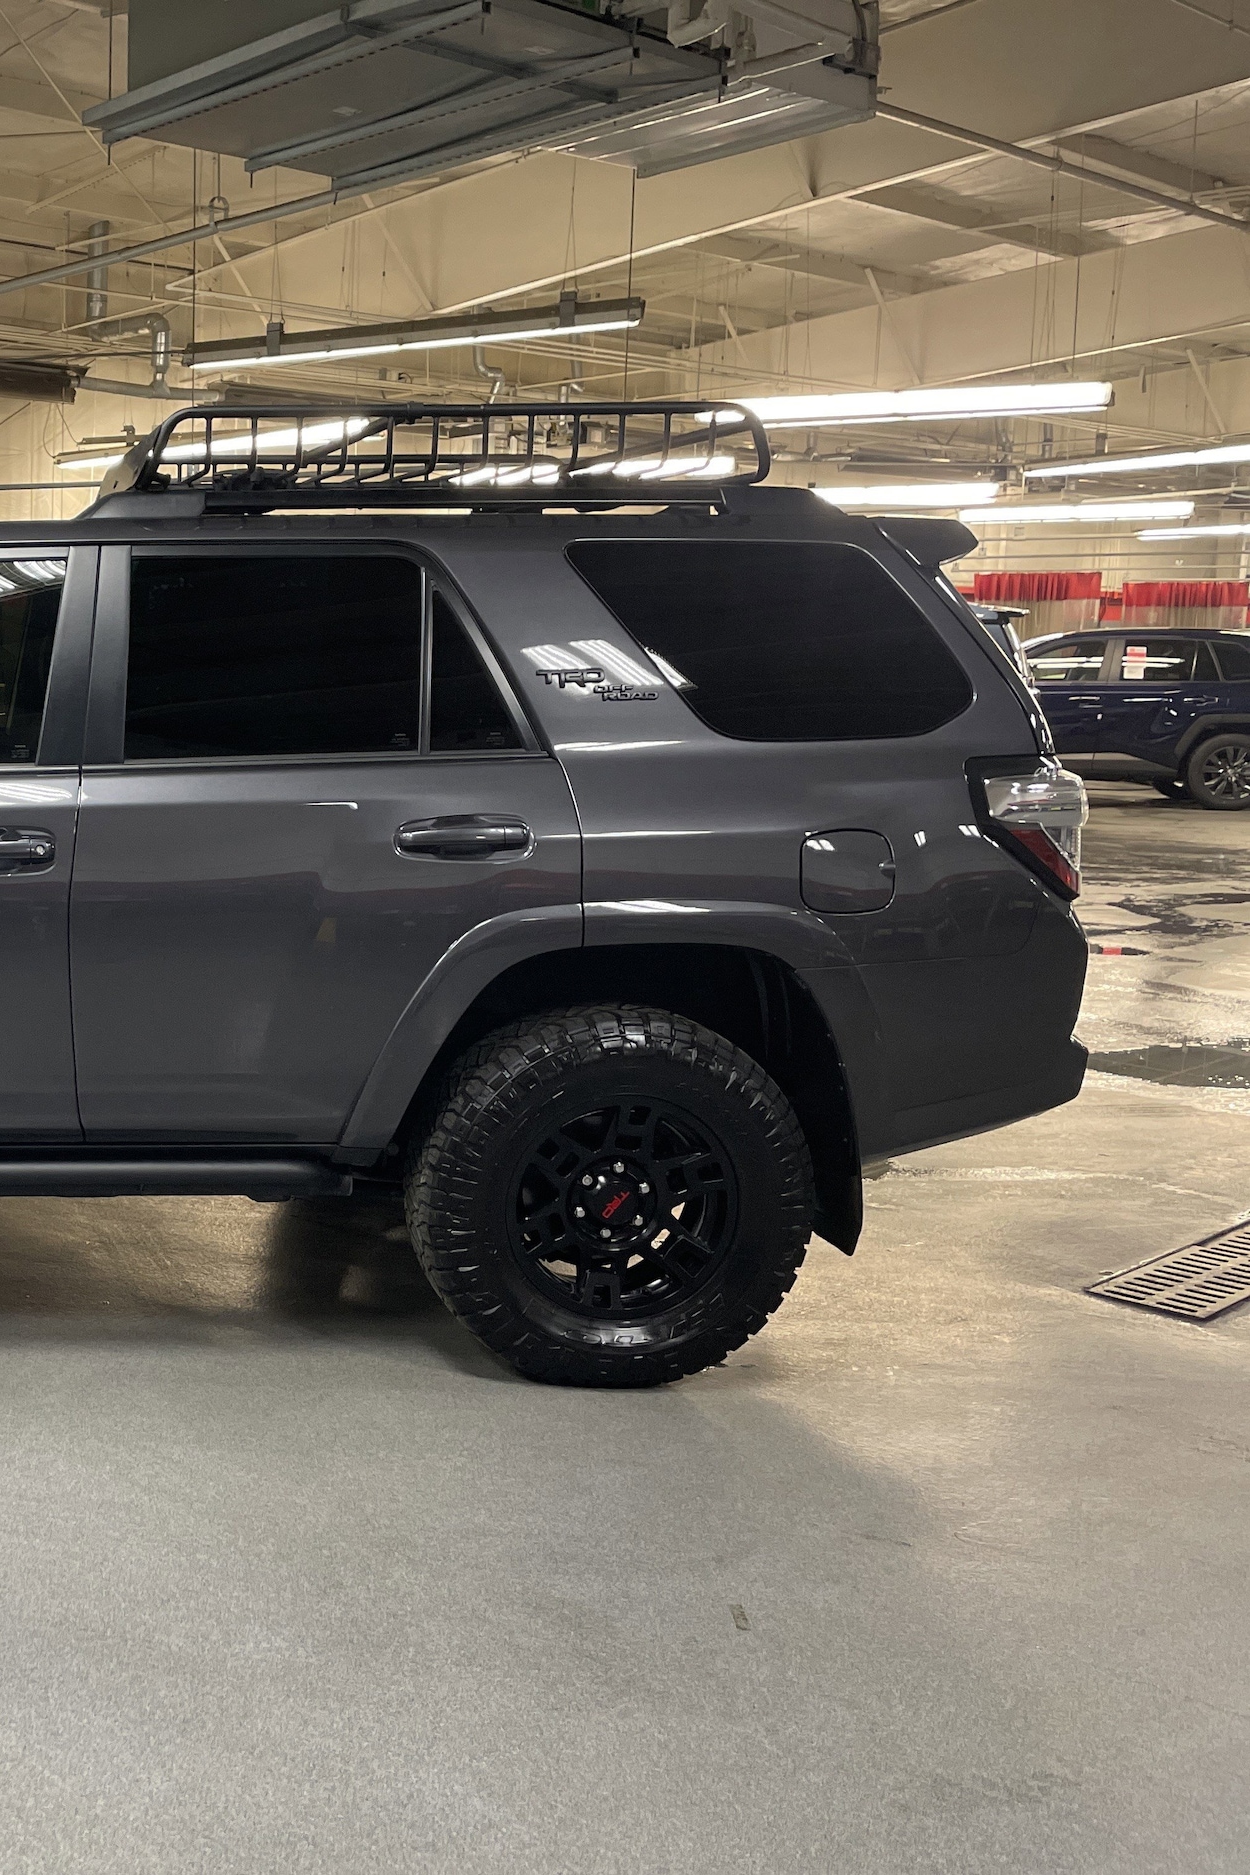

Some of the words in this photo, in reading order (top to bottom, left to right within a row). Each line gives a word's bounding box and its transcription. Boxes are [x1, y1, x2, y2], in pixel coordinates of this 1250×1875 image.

[536, 668, 605, 689] TRD
[593, 684, 634, 694] OFF
[602, 691, 659, 702] ROAD
[601, 1190, 630, 1219] TRD
